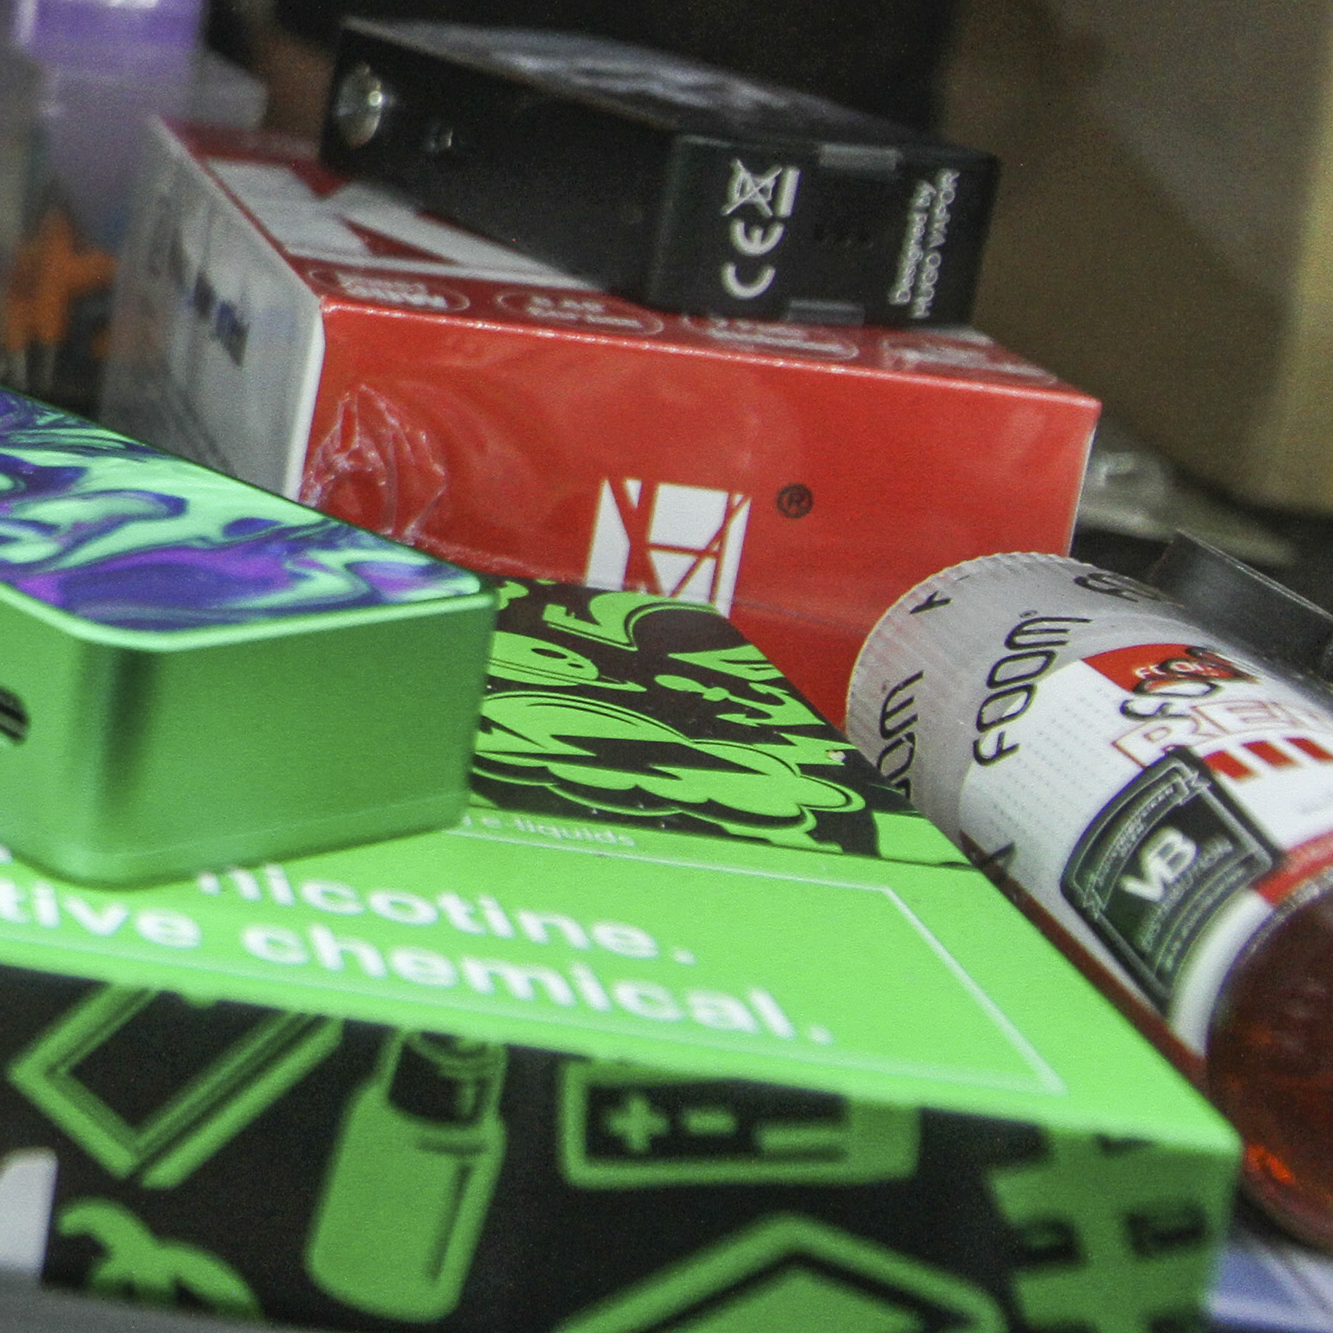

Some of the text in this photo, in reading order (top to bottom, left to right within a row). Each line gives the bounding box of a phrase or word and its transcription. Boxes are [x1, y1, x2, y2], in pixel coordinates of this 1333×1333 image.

[911, 168, 961, 318] HUGO VAPOR
[239, 923, 835, 1047] chemical.
